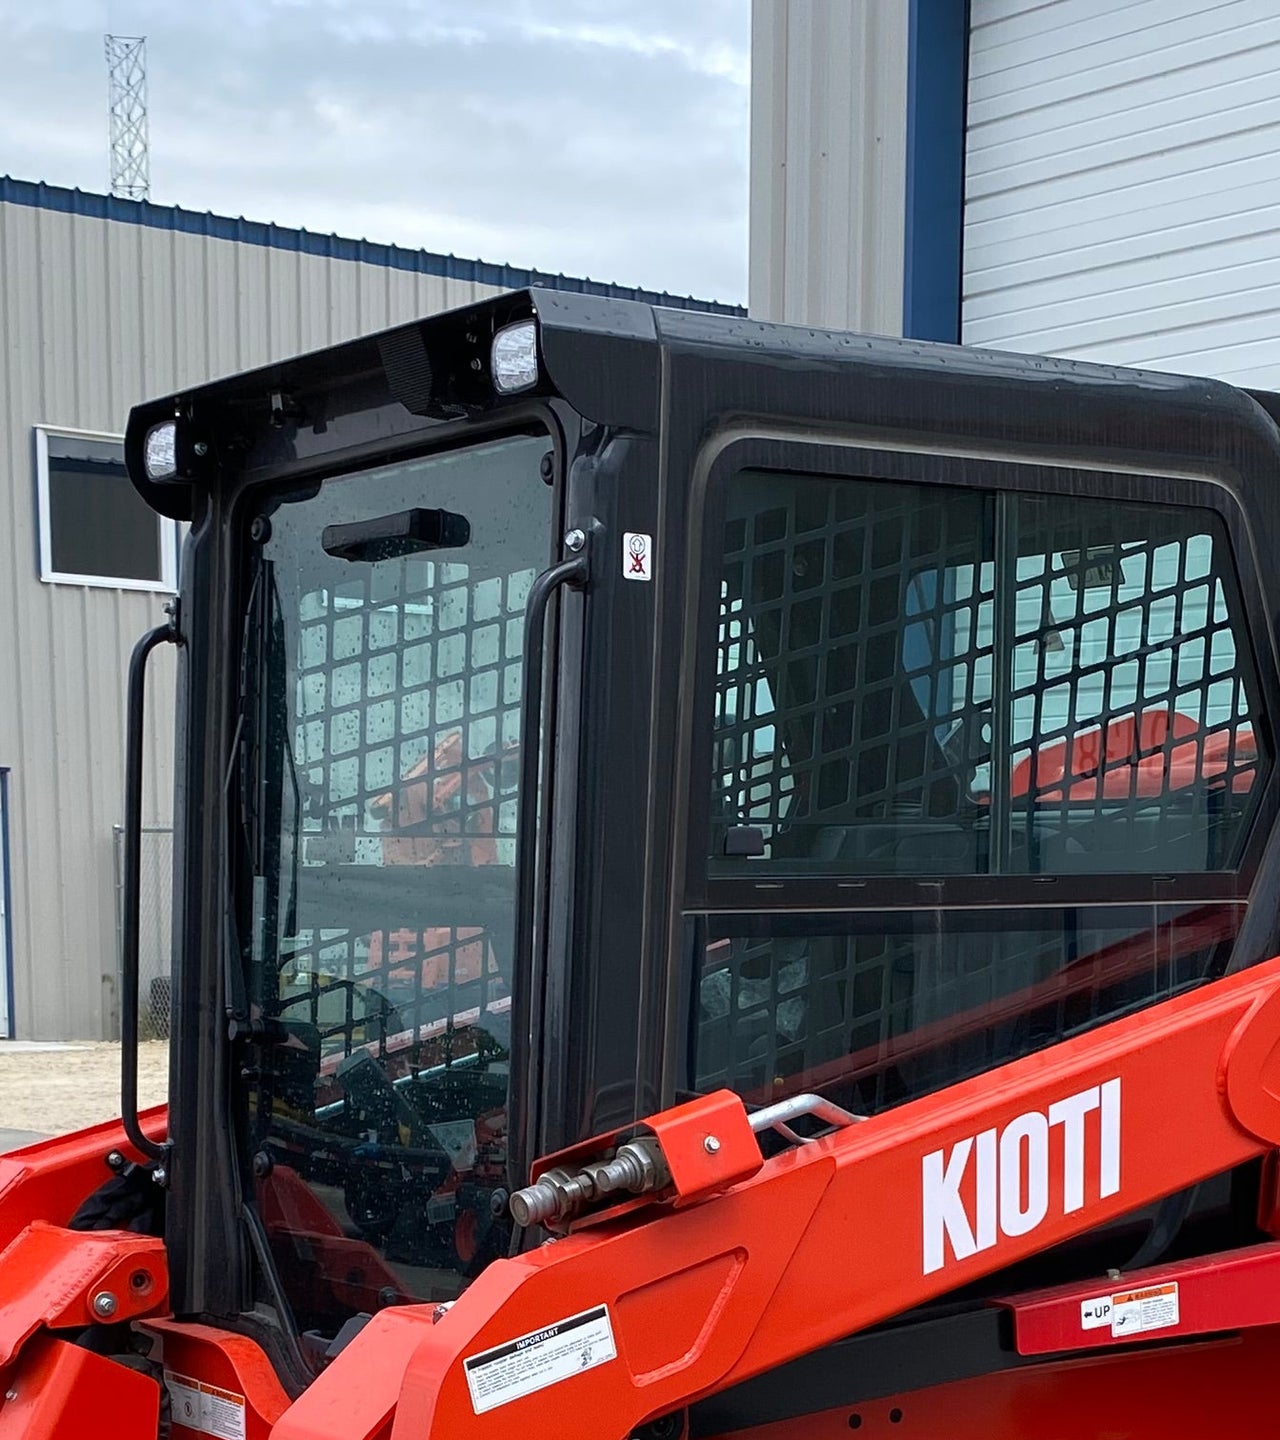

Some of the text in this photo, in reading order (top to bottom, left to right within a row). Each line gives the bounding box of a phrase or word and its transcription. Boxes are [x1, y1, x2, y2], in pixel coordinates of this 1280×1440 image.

[922, 1076, 1121, 1276] KIOTI
[1094, 1304, 1111, 1319] UP
[516, 1326, 560, 1350] IMPORTANT
